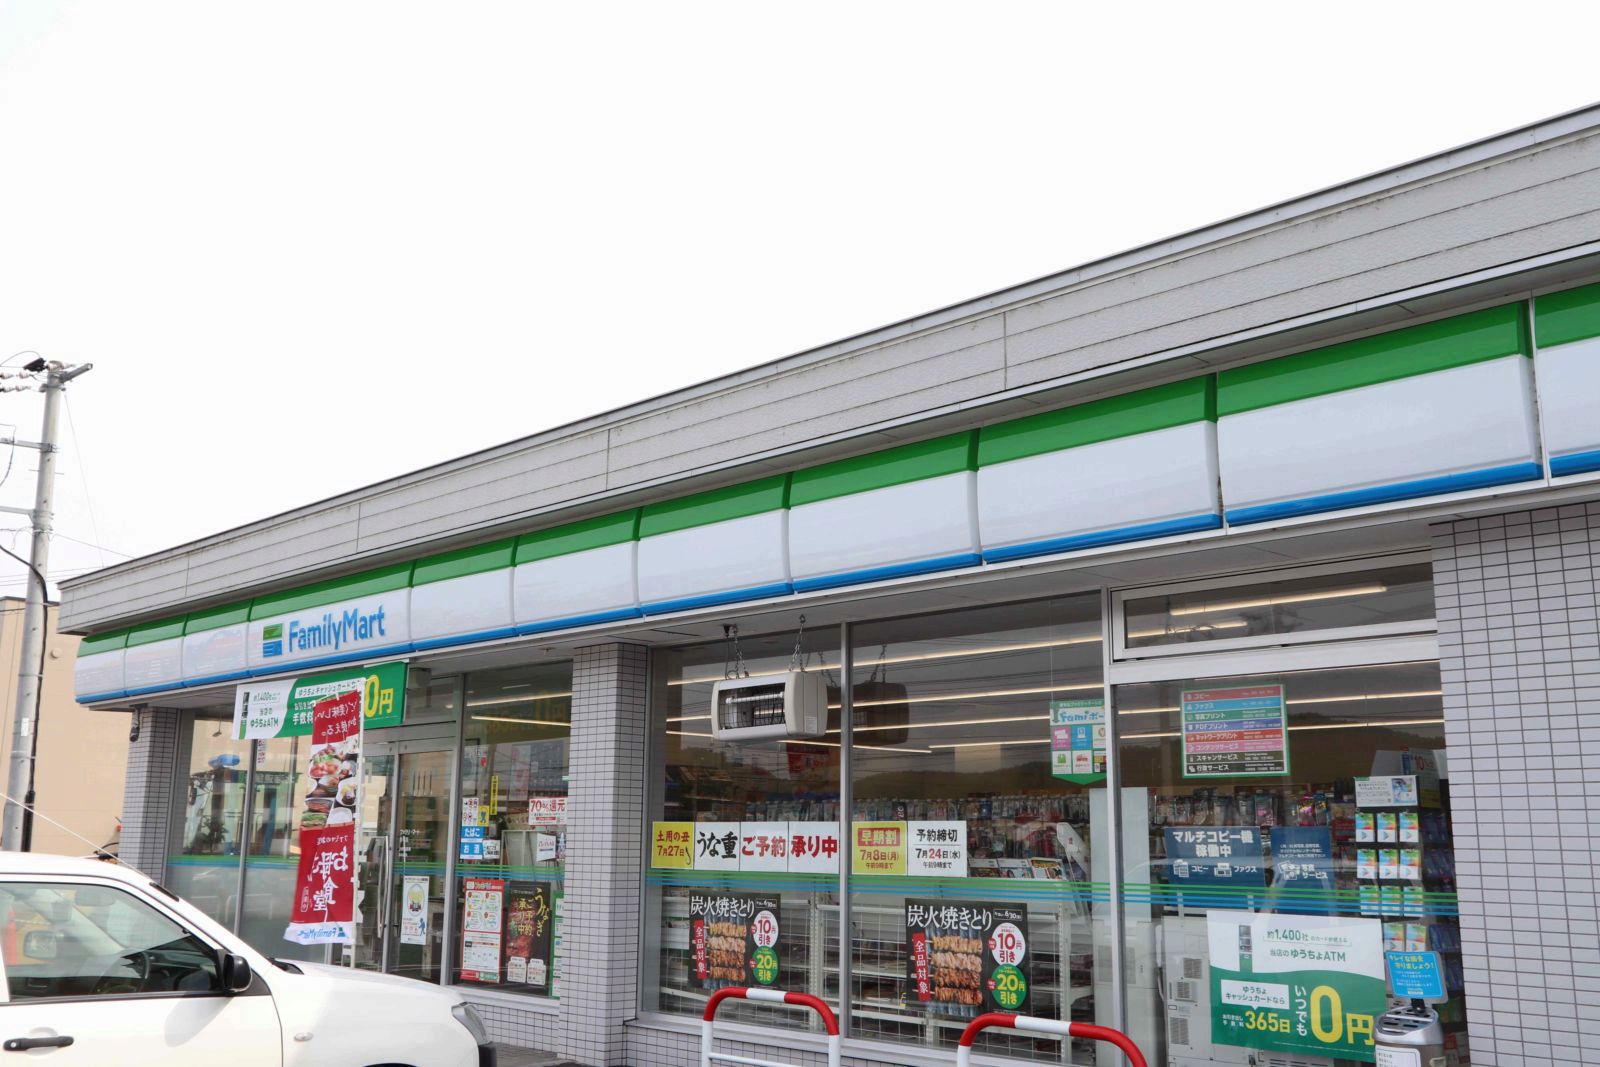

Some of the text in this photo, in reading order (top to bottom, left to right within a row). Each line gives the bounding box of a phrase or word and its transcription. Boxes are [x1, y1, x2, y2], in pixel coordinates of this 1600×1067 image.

[288, 604, 385, 653] FamilyMart
[250, 717, 279, 728] ゆうちょATM
[1196, 753, 1239, 762] スキャンサービス
[464, 827, 480, 838] たばこ
[656, 829, 691, 843] 土用の丑
[916, 828, 958, 843] 予約締切
[1172, 830, 1254, 844] マルチコピー機
[656, 844, 686, 858] 7月27日
[697, 830, 838, 860] うな重 ご予約 承り中
[1195, 844, 1232, 858] 稼働中
[1191, 865, 1209, 873] コピー
[1302, 871, 1329, 879] サービス
[690, 895, 755, 919] 炭火焼きとり
[907, 904, 992, 932] 炭火焼きとり
[695, 926, 706, 973] 全品対象
[999, 950, 1016, 963] 引き
[916, 940, 929, 994] 全品対象
[1242, 985, 1267, 995] ゆうちょ
[1000, 991, 1017, 1005] 引き
[1225, 992, 1286, 1005] キャッシュカードなら
[1294, 984, 1308, 1037] いつでも
[1310, 984, 1376, 1046] 0円
[1245, 1009, 1291, 1034] 365日
